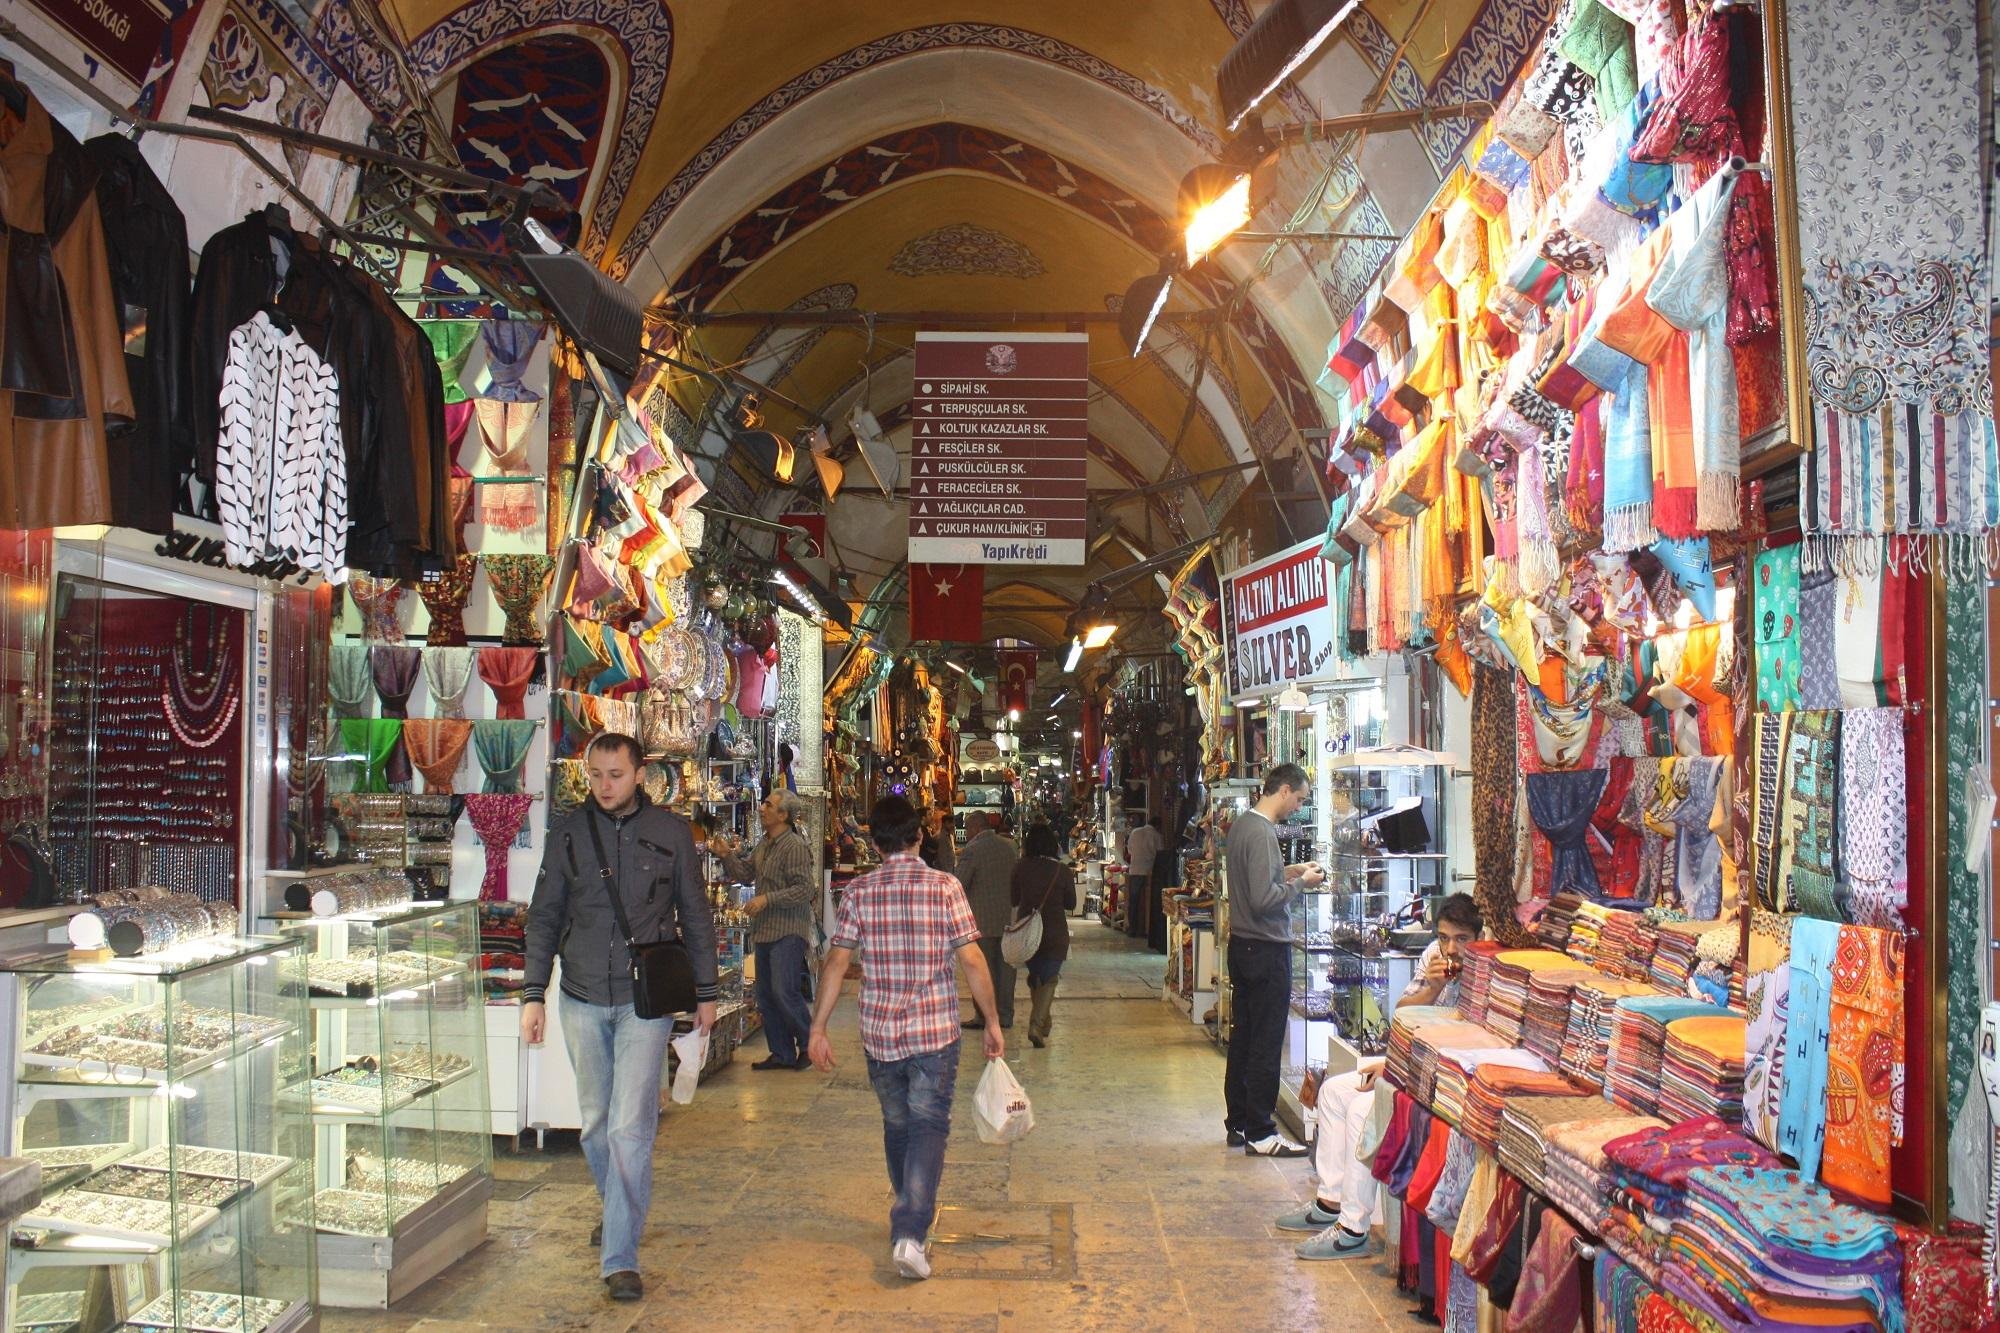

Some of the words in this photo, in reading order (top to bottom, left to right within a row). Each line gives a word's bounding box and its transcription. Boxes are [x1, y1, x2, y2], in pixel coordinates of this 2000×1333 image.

[83, 0, 131, 41] SOKAĞI
[940, 381, 972, 394] SİPAHİ
[973, 384, 989, 395] SK.
[940, 403, 1010, 416] TERPUŞÇULAR
[1012, 404, 1028, 415] SK.
[939, 423, 978, 434] KOLTUK
[980, 424, 1031, 435] KAZAZLAR
[1033, 424, 1049, 435] SK.
[939, 440, 985, 456] FESÇİLER
[987, 443, 1003, 455] SK.
[938, 460, 1009, 475] PUSKÜLCÜLER
[1011, 463, 1027, 475] SK.
[937, 481, 1004, 494] FERACECİLER
[1006, 483, 1022, 494] SK.
[936, 500, 1001, 516] YAĞLIKÇILAR
[1003, 503, 1026, 515] CAD.
[936, 523, 971, 536] ÇUKUR
[981, 543, 1048, 561] YapıKredi
[1239, 575, 1274, 624] ALTIN
[1276, 556, 1324, 612] ALINIR
[1239, 624, 1313, 690] SILVER
